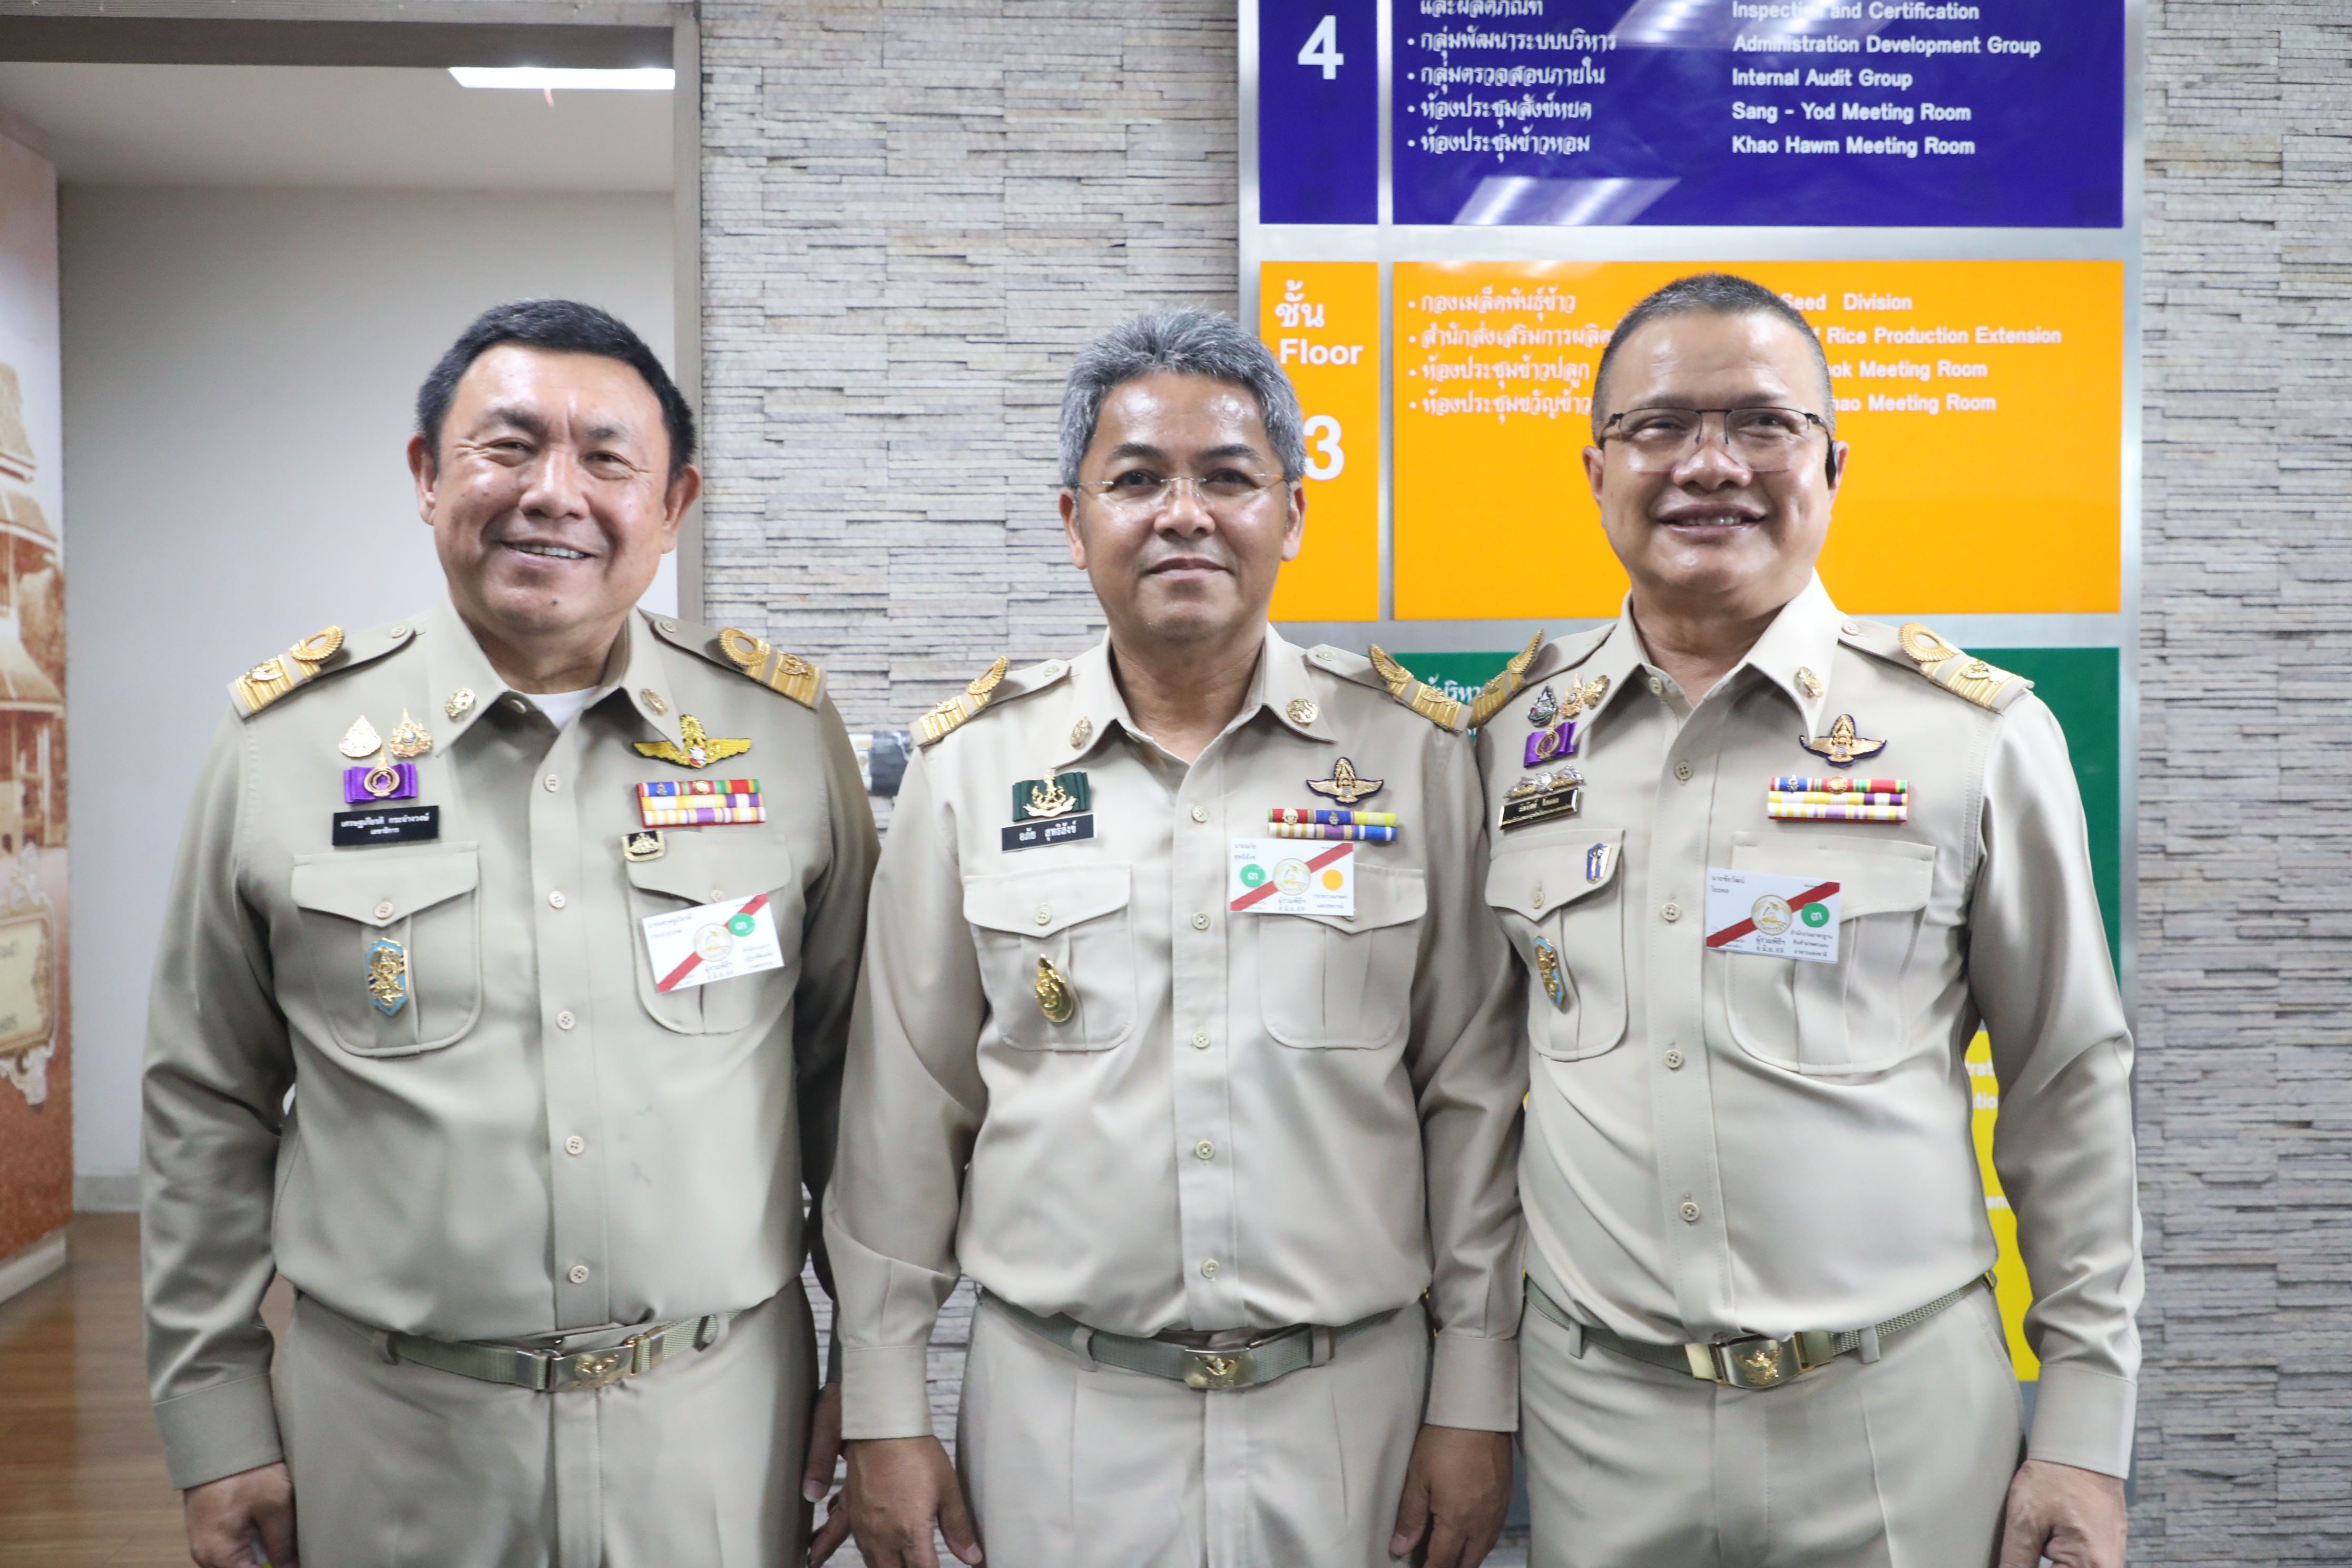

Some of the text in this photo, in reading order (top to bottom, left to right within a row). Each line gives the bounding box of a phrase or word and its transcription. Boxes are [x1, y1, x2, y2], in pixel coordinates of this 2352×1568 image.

[1732, 0, 1979, 22] Inspecti and Certification
[1298, 15, 1345, 80] 4
[1733, 35, 2042, 58] Administration Development Group
[1733, 68, 1913, 92] Internal Audit Group
[1421, 92, 1592, 128] ห้องประชุมสังข์หยด
[1732, 102, 1778, 124] Sang
[1801, 102, 1836, 121] Yod
[1843, 103, 1914, 125] Meeting
[1921, 103, 1972, 121] Room
[1421, 125, 1591, 163] ห้องประชุมข้าวหอม
[1733, 136, 1976, 159] Khao Hawm Meeting Room
[1275, 280, 1326, 329] ชั้น
[1421, 285, 1577, 322] กองเมล็ดพันธุ์ข้าว
[1780, 293, 1913, 311] Seed Division
[1827, 327, 1868, 345] Rice
[1874, 326, 1969, 345] Production
[1975, 326, 2063, 345] Extension
[1280, 338, 1364, 365] Floor
[1421, 353, 1591, 390] ห้องประชุมข้าวปลูก
[1859, 360, 1932, 383] Meeting
[1937, 360, 1989, 378] Room
[1421, 387, 1592, 425] ห้องประชุมขวัญข้าว
[1868, 394, 1941, 416] Meeting
[1946, 393, 1997, 412] Room
[1304, 415, 1345, 481] 3
